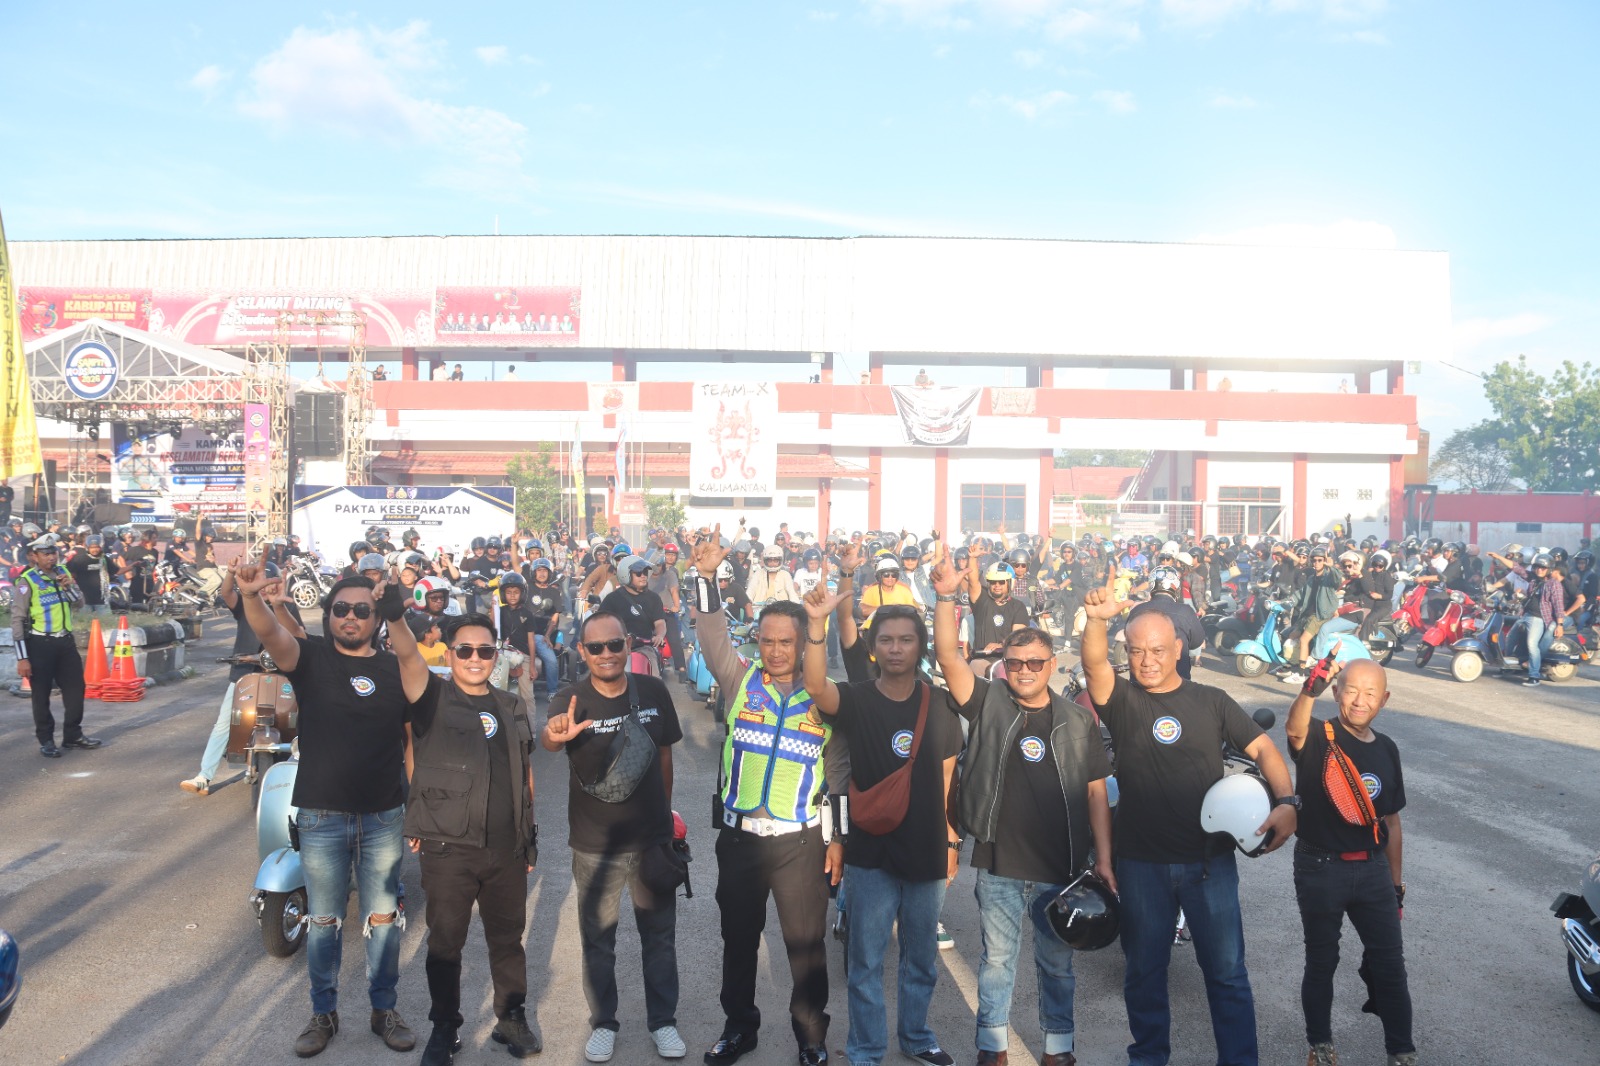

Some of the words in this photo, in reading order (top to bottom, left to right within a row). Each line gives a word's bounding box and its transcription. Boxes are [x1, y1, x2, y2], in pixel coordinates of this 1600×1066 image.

[64, 301, 136, 312] KABUPATEN
[236, 296, 291, 310] SELAMAT
[292, 297, 344, 310] DATANG
[160, 451, 216, 463] KESELAMATAN
[698, 482, 767, 494] KALIMANTAN
[335, 504, 376, 513] PAKTA
[380, 504, 471, 515] KESEPAKATAN
